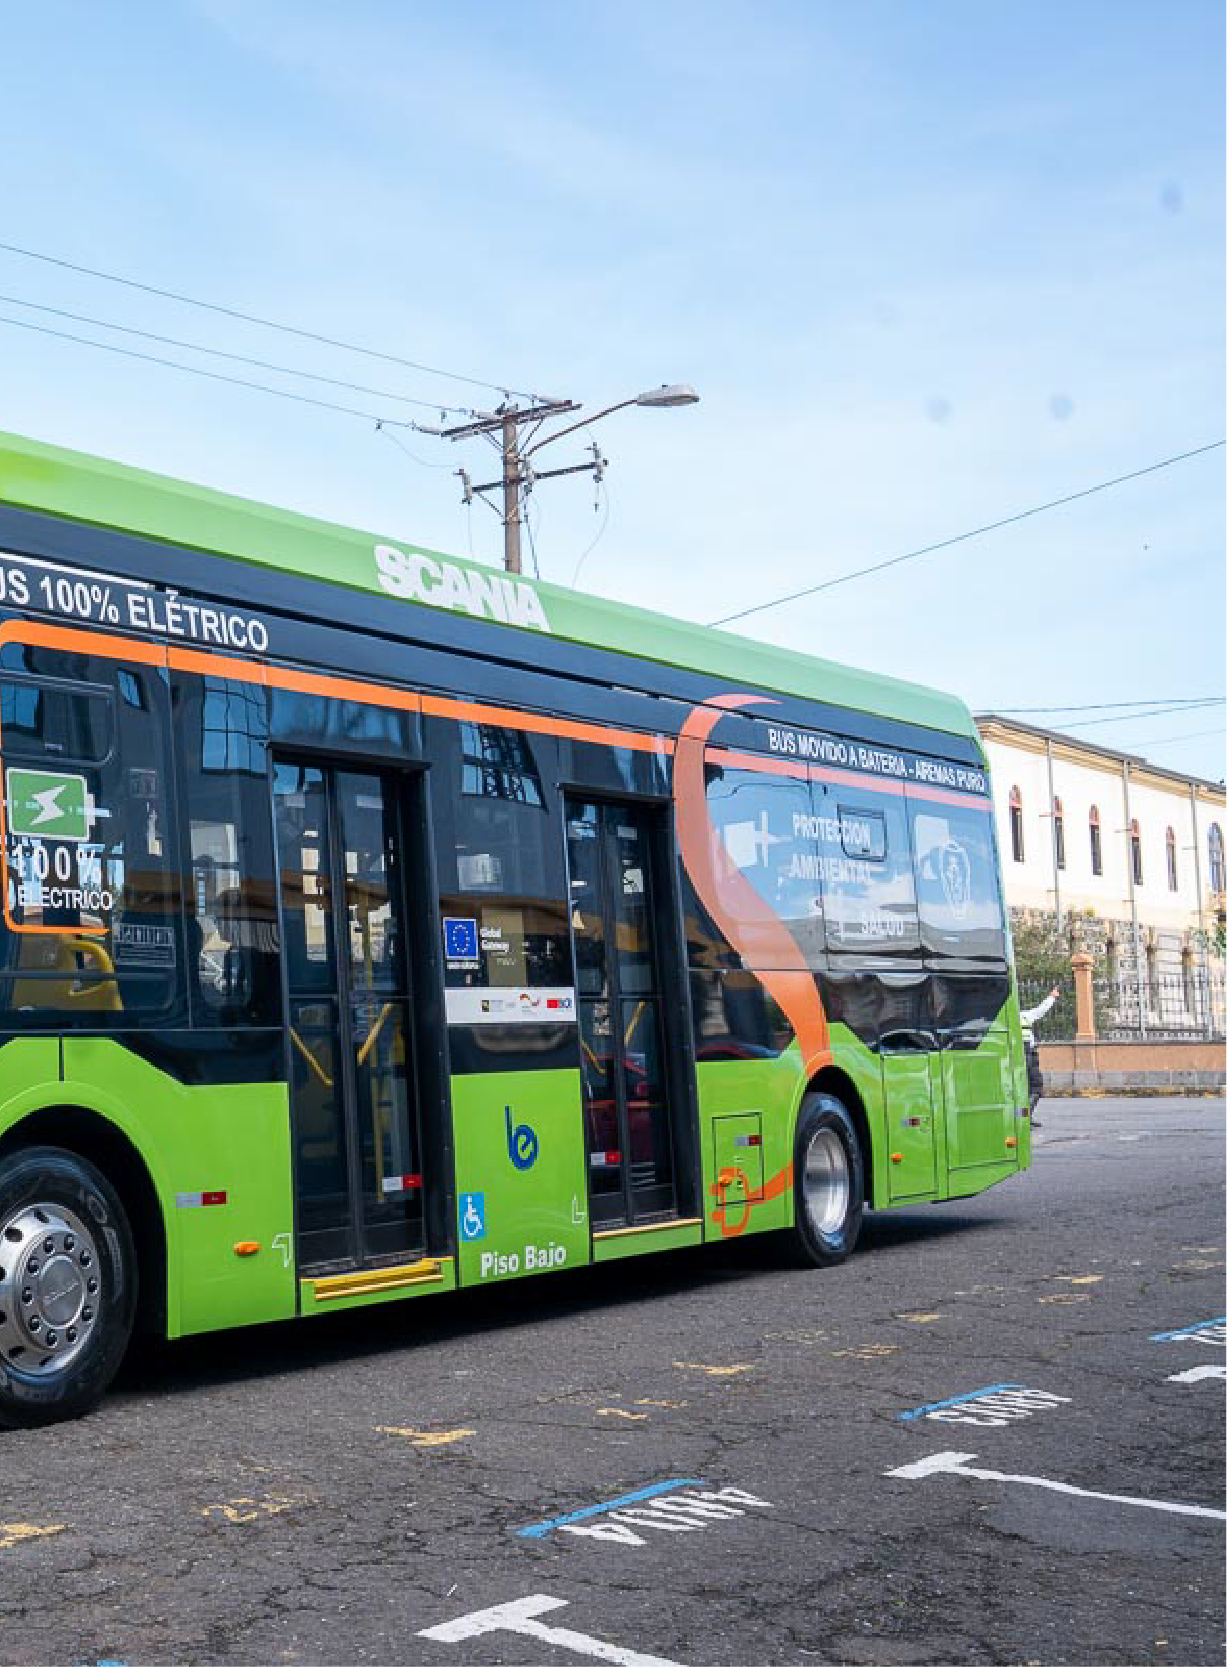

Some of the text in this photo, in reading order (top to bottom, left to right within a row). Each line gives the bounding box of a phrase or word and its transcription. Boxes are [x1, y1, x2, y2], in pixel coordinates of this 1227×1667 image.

[374, 544, 552, 633] SCANIA
[40, 575, 119, 624] 100%
[127, 588, 269, 652] ELÉTRICO
[768, 728, 796, 753] BUS
[797, 734, 848, 764] MOVIDO
[859, 748, 908, 778] BATERIA
[13, 844, 104, 882] 100%
[18, 884, 113, 911] ELECTRICO
[480, 1242, 566, 1278] Piso Bajo
